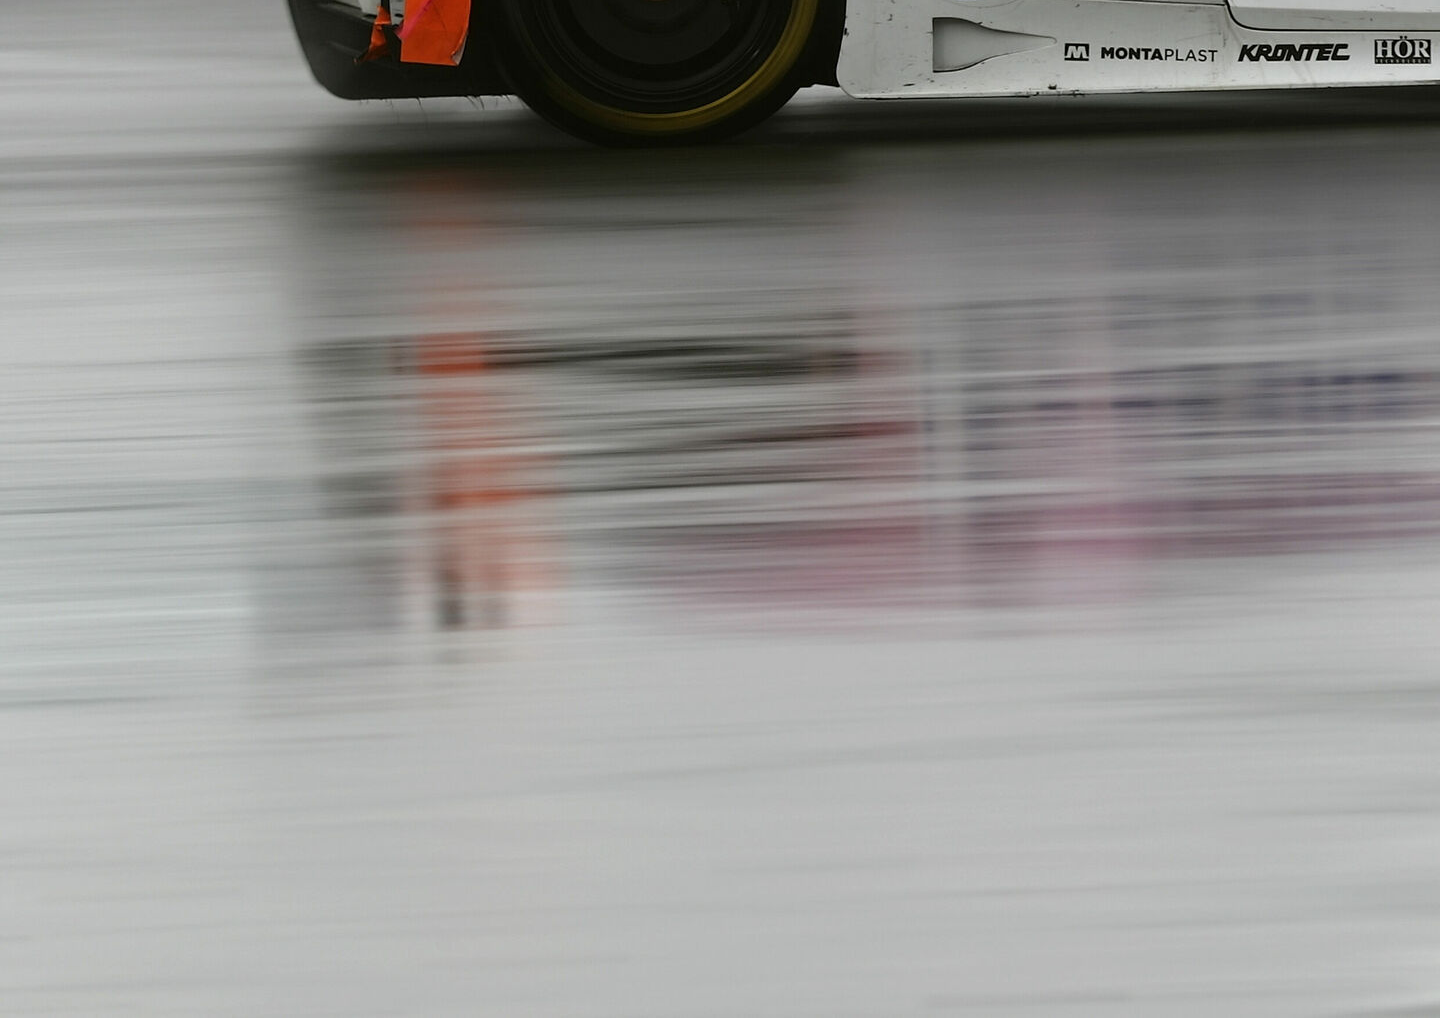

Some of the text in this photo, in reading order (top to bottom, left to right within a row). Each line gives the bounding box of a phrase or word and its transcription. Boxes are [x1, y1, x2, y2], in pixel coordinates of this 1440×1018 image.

[1100, 46, 1218, 62] MONTAPLAST
[1237, 43, 1351, 62] KRONTEC
[1375, 35, 1430, 58] HÖR
